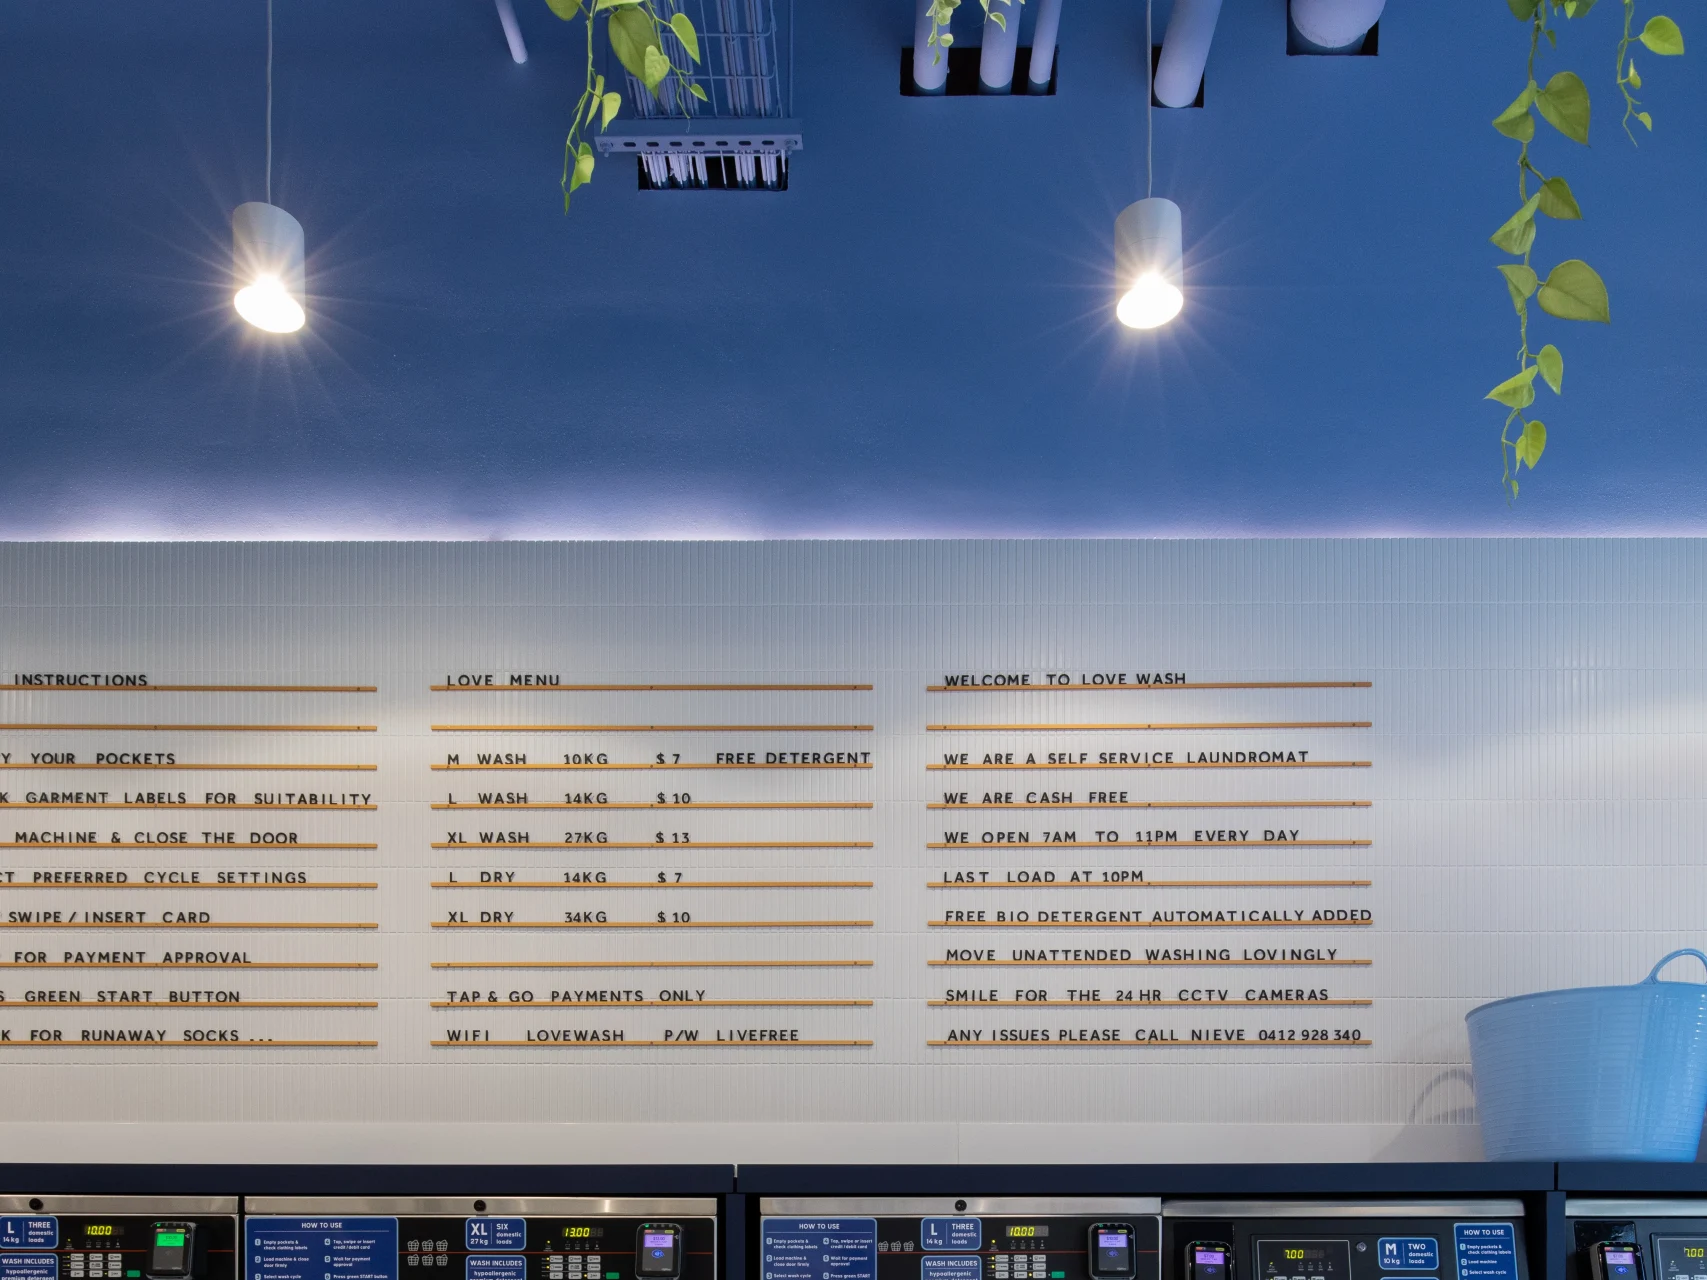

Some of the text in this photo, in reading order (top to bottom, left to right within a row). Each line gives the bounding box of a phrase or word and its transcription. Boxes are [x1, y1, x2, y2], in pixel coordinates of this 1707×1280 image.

[14, 673, 148, 686] INSTRUCTIONS
[447, 674, 560, 687] LOVE MENU
[943, 673, 1186, 686] WELCOME TO LOVE WASH
[30, 752, 176, 765] YOUR POCKETS
[447, 752, 871, 765] M WASH 10KG FREE DETERGENT
[944, 752, 1309, 765] WE ARE A SELF SERVICE LAUNDROMAT
[25, 792, 371, 804] GARMENT LABELS FOR SUITABILITY
[448, 792, 608, 805] L WASH 14KG
[943, 792, 1128, 804] WE ARE CASH FREE
[15, 831, 298, 844] MACHINE CLOSE THE DOOR
[447, 831, 608, 844] XL WASH 27KG
[944, 830, 1299, 843] WE OPEN 7AM TO 11PM EVERY DAY
[33, 871, 307, 884] PREFERRED CYCLE SETTINGS
[449, 871, 607, 883] L DRY 14KG
[943, 871, 1143, 883] LAST LOAD AT 10PM
[162, 911, 210, 924] CARD
[448, 911, 607, 923] XL DRY 34KG
[945, 910, 1372, 922] FREE BIO DETERGENT AUTOMATICALLY ADDED
[14, 951, 251, 964] FOR PAYMENT APPROVAL
[946, 949, 1337, 961] MOVE UNATTENDED WASHING LOVINGLY
[24, 990, 240, 1003] GREEN START BUTTON
[446, 990, 705, 1003] TAP GO PAYMENTS ONLY
[945, 989, 1329, 1002] SMILE FOR THE CCTV CAMERAS
[30, 1029, 239, 1042] FOR RUNAWAY SOCKS
[446, 1029, 799, 1042] WIFI LOVEWASH P/W LIVEFREE
[947, 1029, 1362, 1041] ANY ISSUES PLEASE CALL NIEVE 0412 928 340
[7, 1221, 15, 1234] L
[28, 1221, 51, 1229] THREE
[471, 1223, 488, 1236] XL
[931, 1223, 938, 1236] L
[1385, 1243, 1397, 1256] M
[473, 1270, 517, 1278] hypoallergenic
[929, 1270, 972, 1278] hypoallergenic
